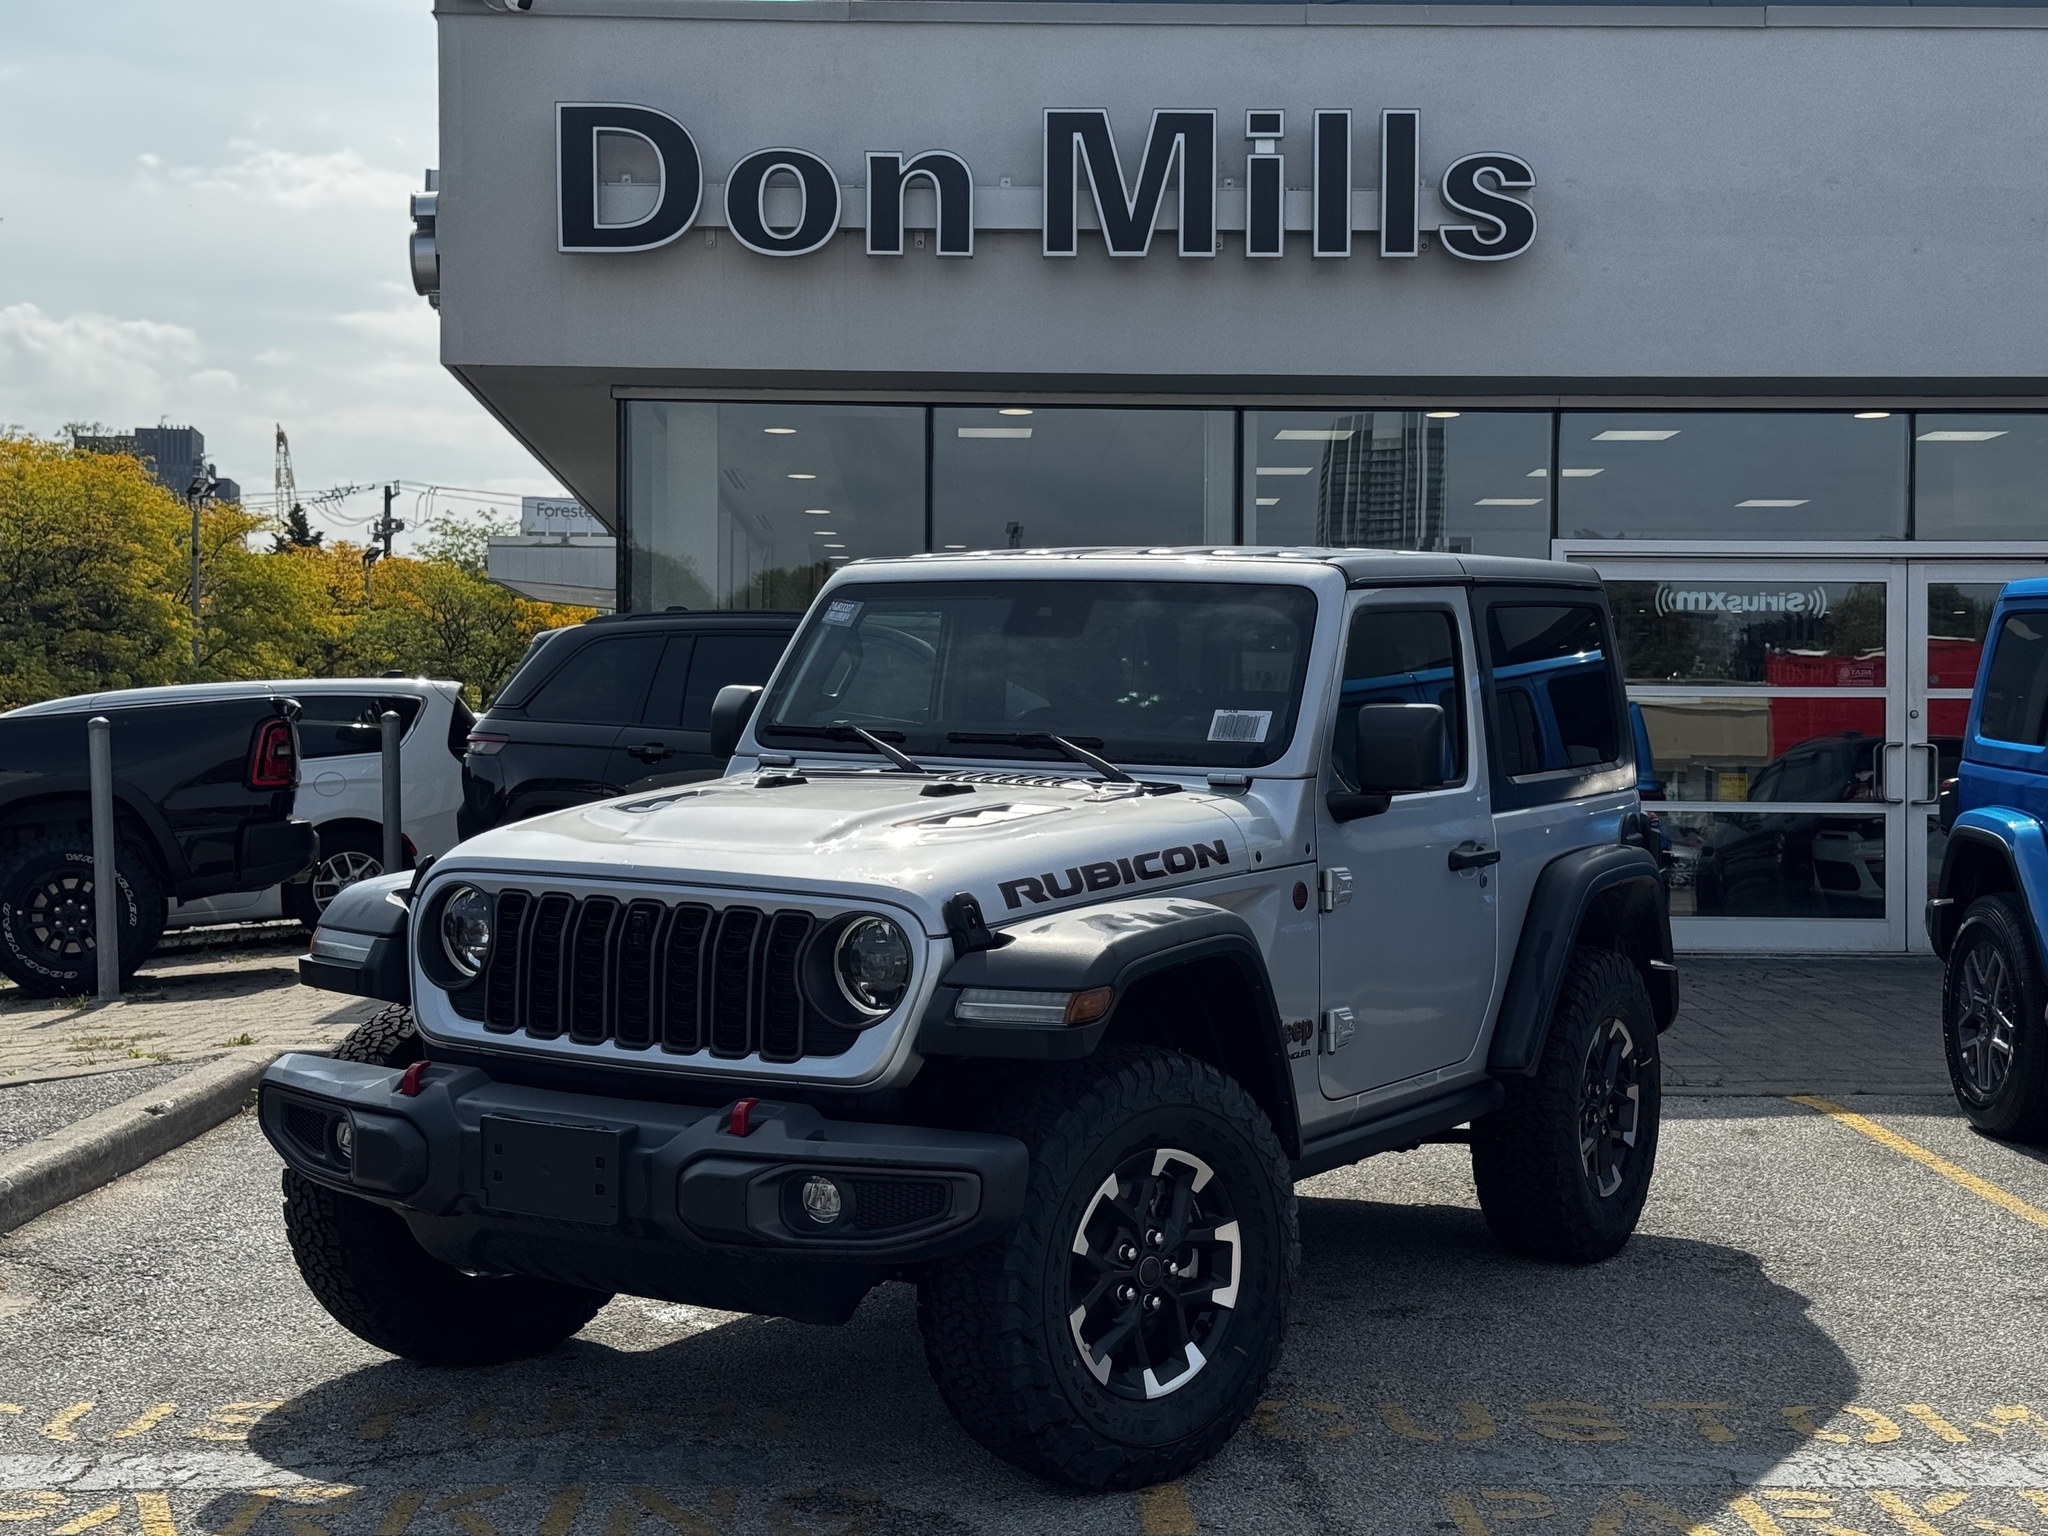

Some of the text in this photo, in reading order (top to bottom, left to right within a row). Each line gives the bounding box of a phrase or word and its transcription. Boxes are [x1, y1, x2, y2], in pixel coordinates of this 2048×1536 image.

[554, 100, 1539, 264] Don Mills
[997, 839, 1231, 910] RUBICON
[3, 902, 78, 979] GOODYEAR
[1283, 1019, 1313, 1046] eep
